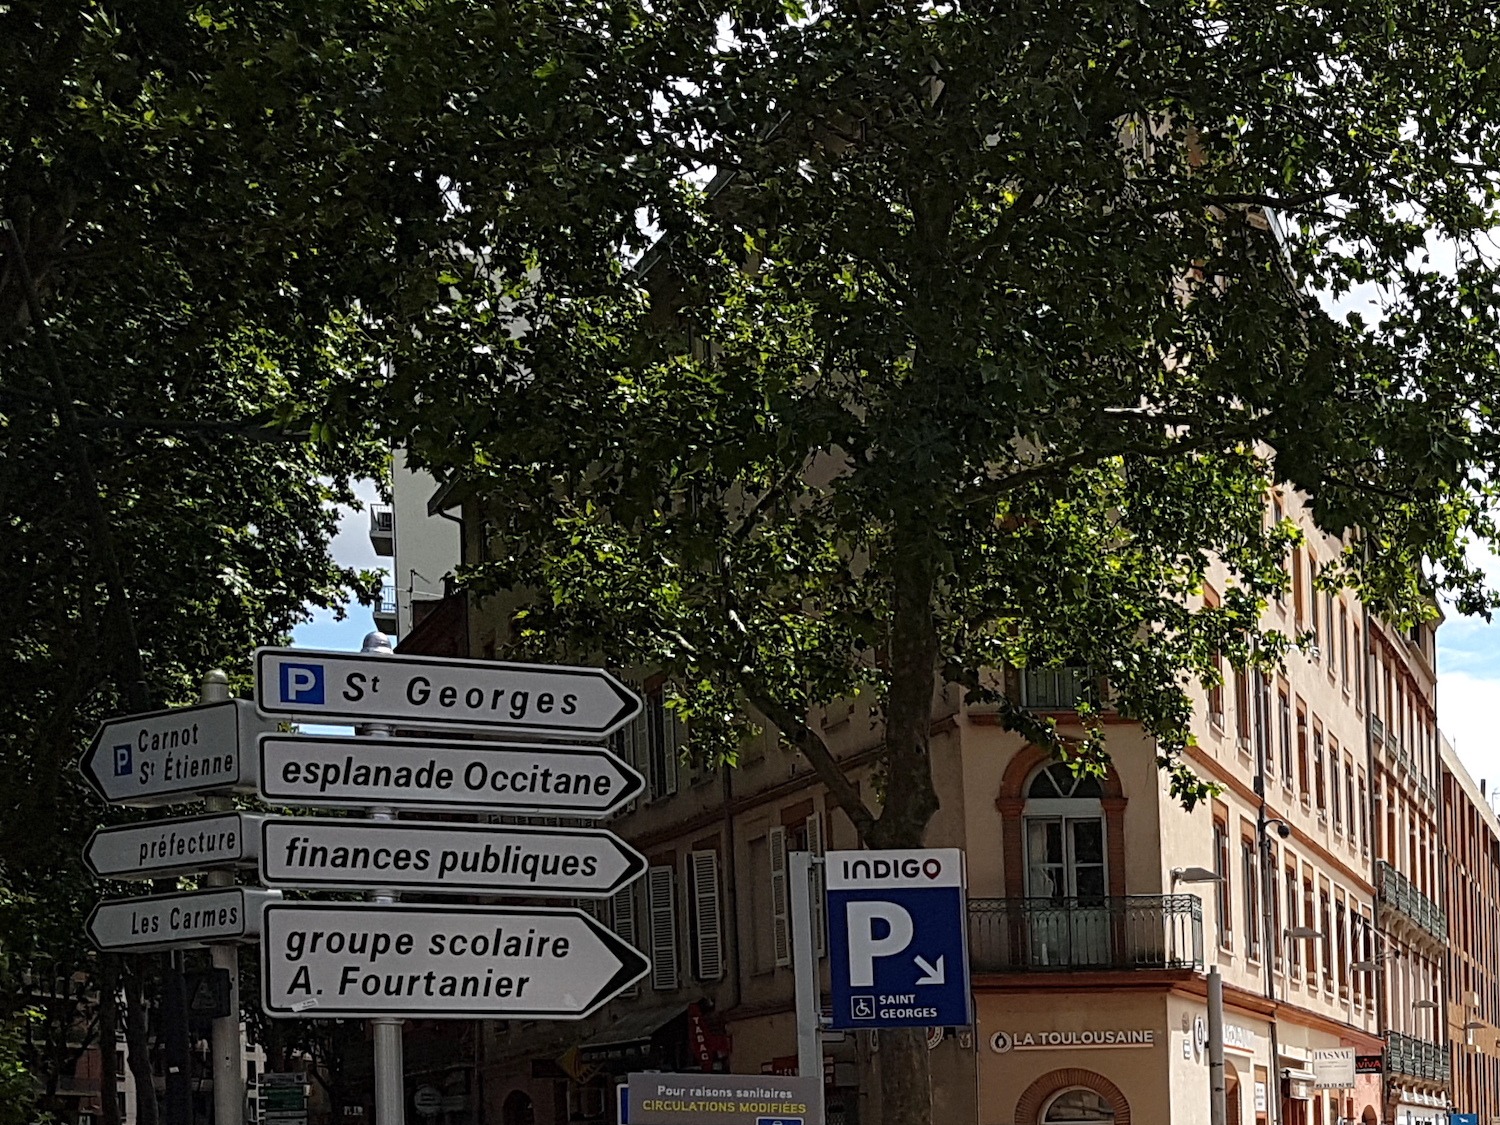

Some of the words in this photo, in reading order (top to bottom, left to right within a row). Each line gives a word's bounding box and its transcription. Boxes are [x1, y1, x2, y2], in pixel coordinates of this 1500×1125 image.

[342, 672, 381, 702] St
[406, 676, 579, 720] Georges
[137, 723, 200, 753] Carnot
[162, 745, 235, 784] Étienne
[281, 756, 454, 792] esplanade
[463, 761, 613, 797] Occitane
[138, 826, 236, 864] préfecture
[284, 836, 431, 871] finances
[437, 842, 599, 880] publiques
[843, 858, 942, 880] INDIGO
[131, 909, 160, 935] Les
[169, 903, 239, 931] Carmes
[285, 927, 414, 961] groupe
[427, 918, 571, 959] scolaire
[846, 900, 914, 987] P
[286, 966, 325, 997] A.
[337, 966, 531, 998] Fourtanier
[879, 994, 916, 1005] SAINT
[880, 1007, 938, 1019] GEORGES
[1013, 1032, 1035, 1047] LA
[1039, 1030, 1154, 1046] TOULOUSAINE
[642, 1100, 736, 1113] CIRCULATIONS
[738, 1100, 807, 1115] MODIFIÉES
[657, 1085, 686, 1098] Pour
[689, 1086, 732, 1099] raisons
[736, 1087, 793, 1100] sanitaires
